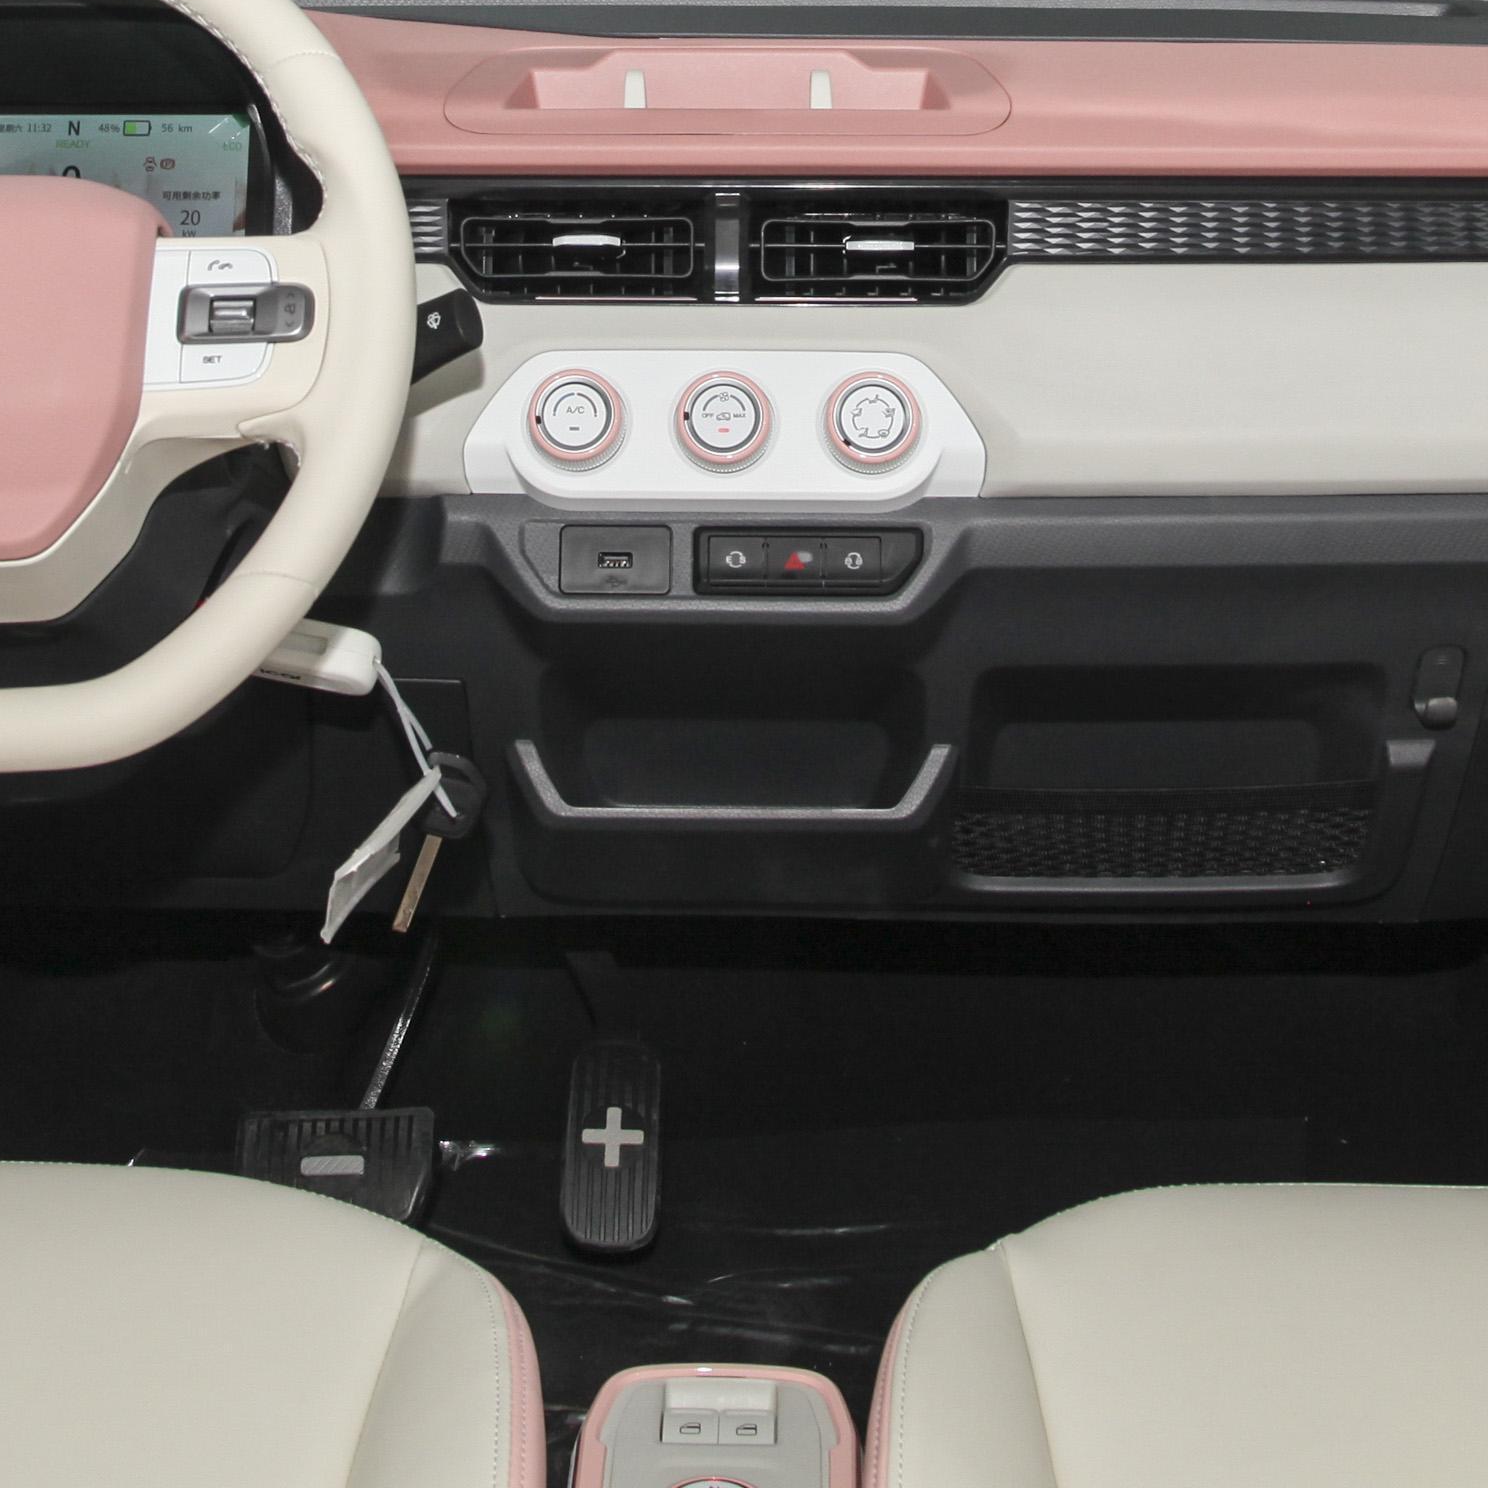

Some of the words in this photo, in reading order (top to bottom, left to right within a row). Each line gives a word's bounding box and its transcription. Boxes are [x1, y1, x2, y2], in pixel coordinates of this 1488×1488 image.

[27, 123, 52, 133] 11:32
[68, 120, 81, 136] N
[98, 123, 121, 134] 48%
[161, 123, 174, 133] 56
[178, 123, 193, 133] km
[55, 139, 91, 150] READY
[180, 209, 201, 226] 20
[202, 355, 223, 364] SET
[566, 405, 585, 415] A/C
